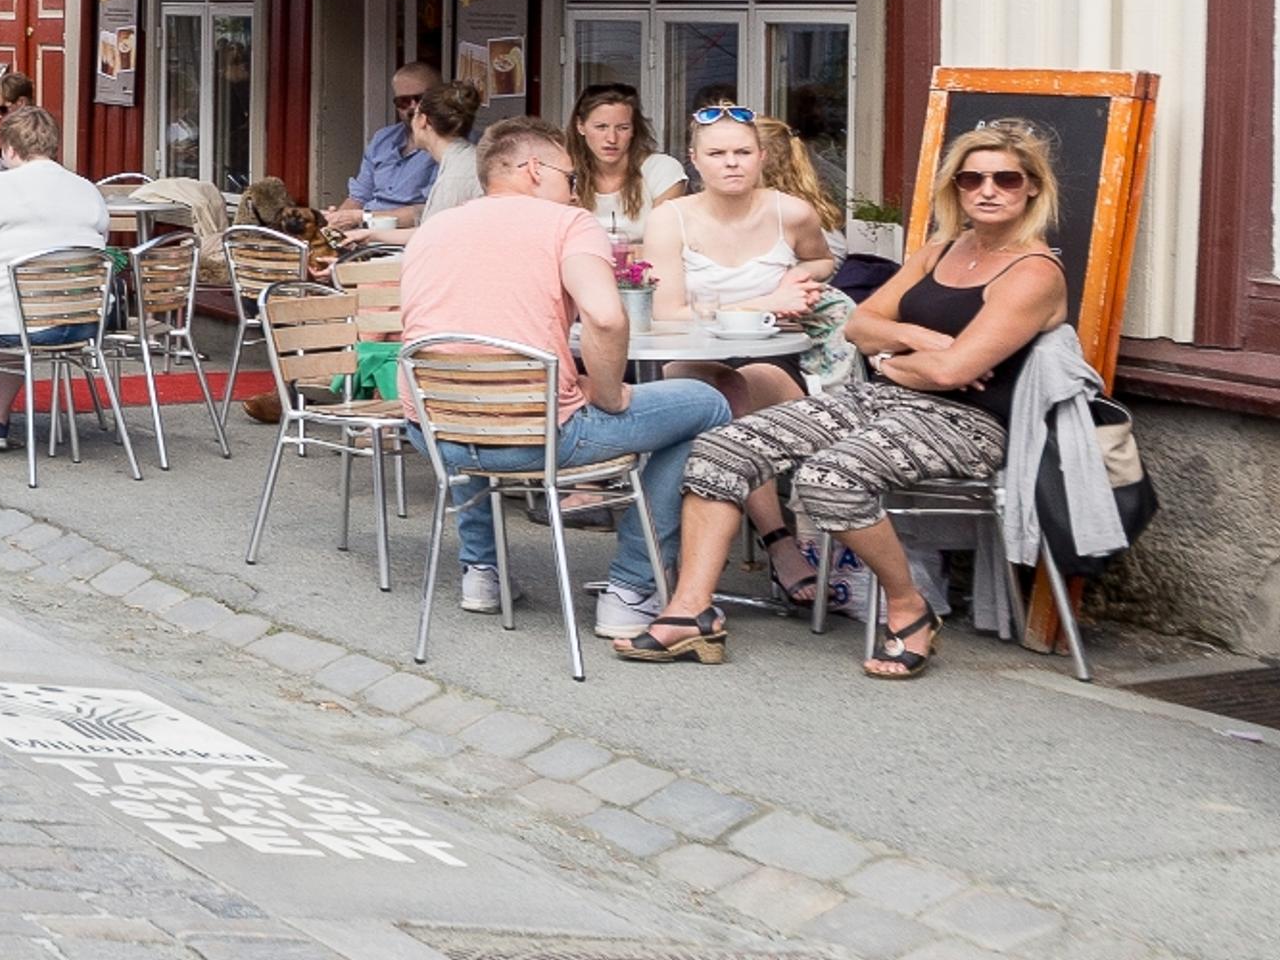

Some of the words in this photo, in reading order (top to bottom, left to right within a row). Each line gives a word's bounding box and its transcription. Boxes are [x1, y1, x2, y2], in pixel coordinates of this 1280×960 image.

[31, 757, 348, 799] TAKK
[75, 782, 202, 804] FOR
[217, 792, 286, 810] AT
[308, 797, 381, 816] DU
[110, 800, 433, 838] SYKLER
[144, 821, 468, 867] PENT
